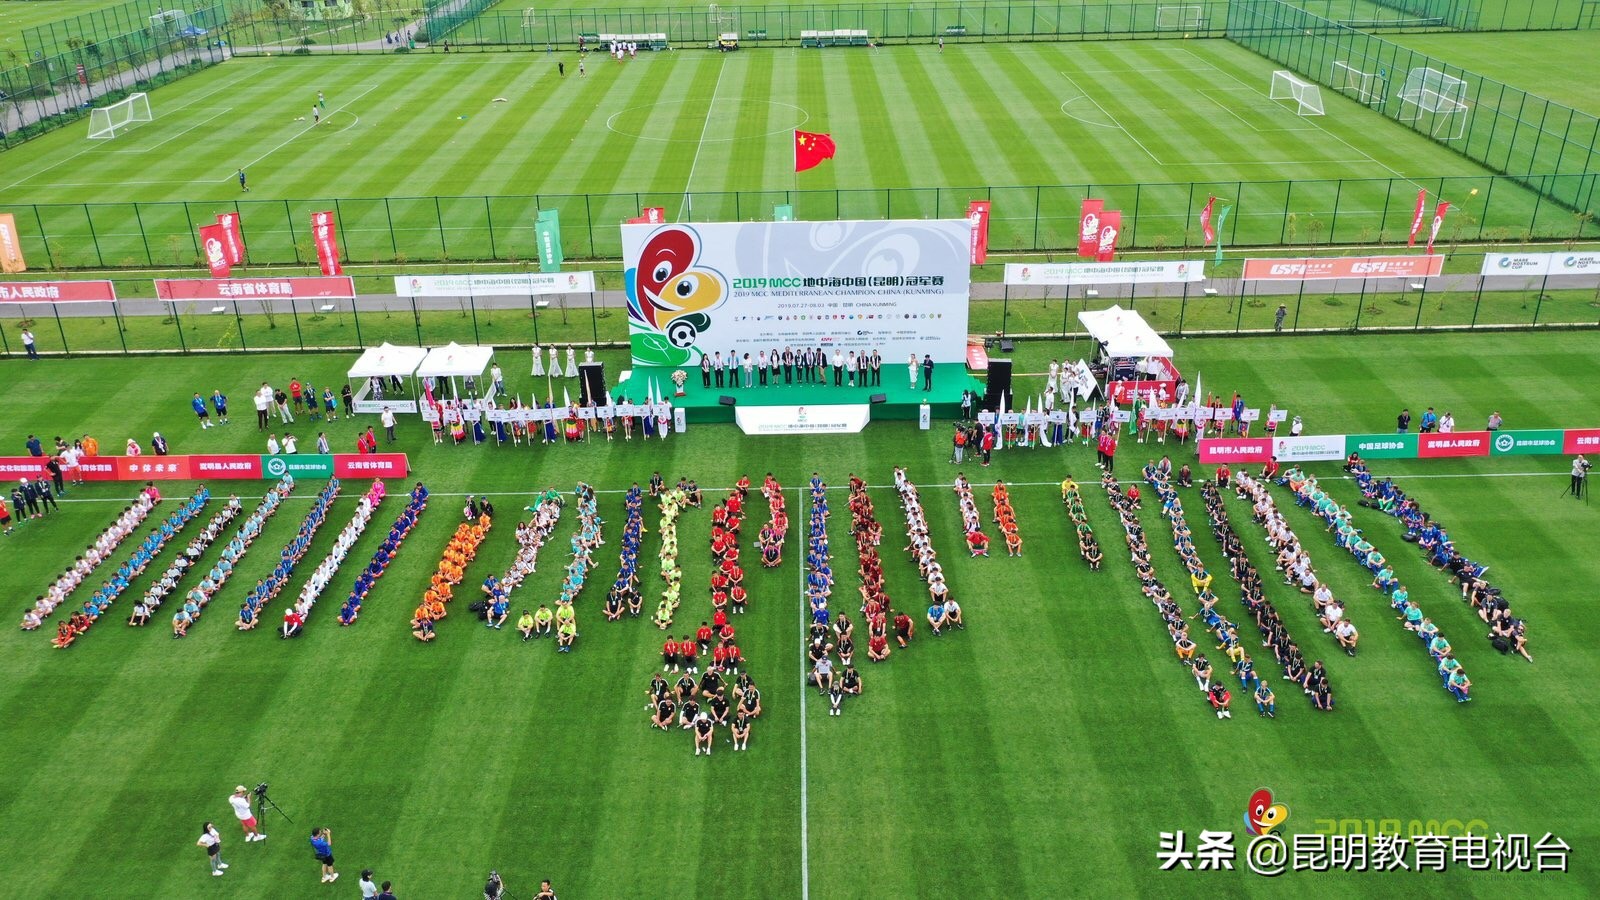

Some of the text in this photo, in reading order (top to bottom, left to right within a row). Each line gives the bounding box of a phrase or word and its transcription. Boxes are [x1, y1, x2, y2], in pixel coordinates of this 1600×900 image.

[733, 276, 944, 289] 2019 MCC 地中海中国(昆明)冠军赛
[0, 286, 59, 298] 市人民政府
[218, 283, 292, 296] 云南省体育局
[1428, 439, 1480, 448] 嵩明县人民政府
[1576, 436, 1600, 445] 云南省
[1359, 441, 1404, 450] 中国足球协会
[1209, 446, 1263, 455] 昆明市人民政府
[129, 463, 177, 472] 中体未来
[347, 461, 393, 469] 云南省体育局
